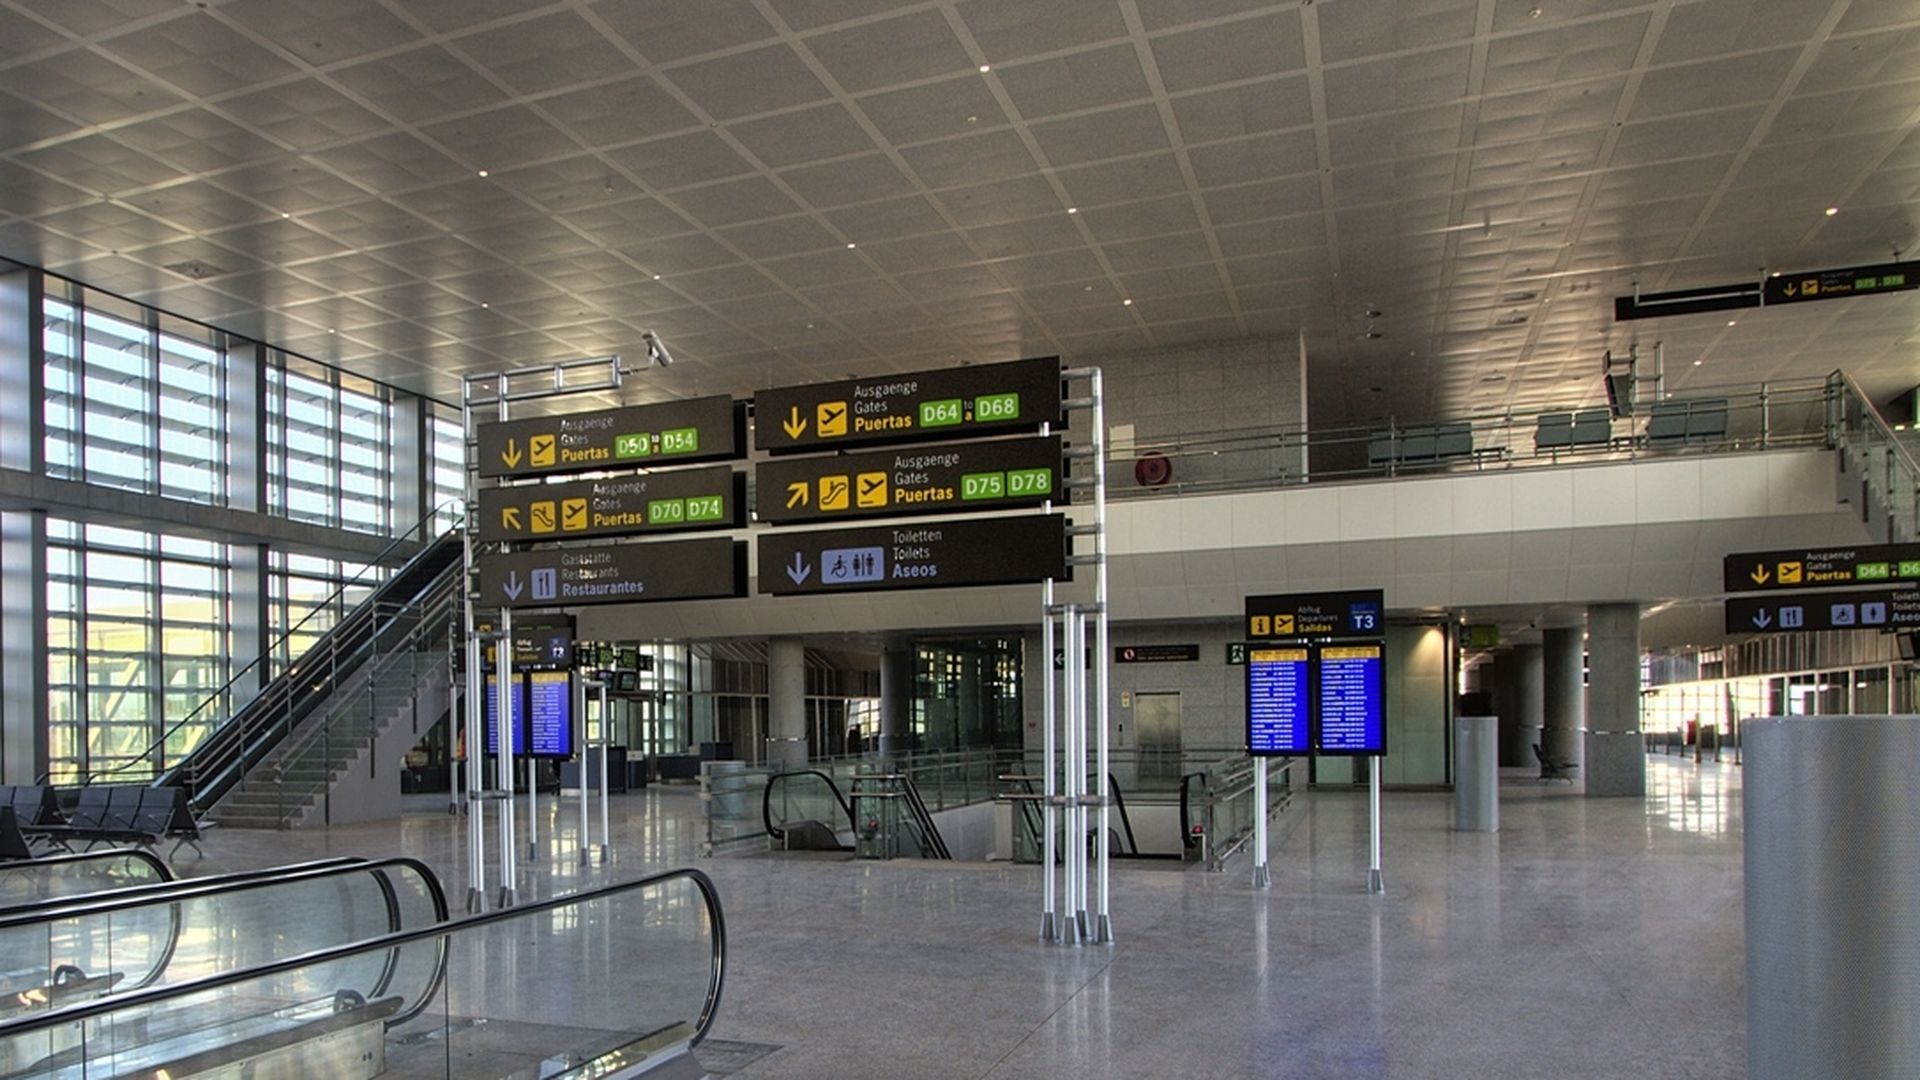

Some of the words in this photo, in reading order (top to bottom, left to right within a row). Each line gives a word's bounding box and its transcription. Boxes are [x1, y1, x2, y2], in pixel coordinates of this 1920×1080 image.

[854, 381, 918, 398] Ausgaenge
[854, 401, 888, 415] Gates
[855, 415, 912, 432] Puertas
[924, 404, 958, 423] D64
[979, 398, 1014, 417] D68
[560, 417, 613, 432] Ausgaenge
[561, 434, 589, 446] Gates
[561, 447, 609, 463] Puertas
[619, 437, 648, 454] D50
[664, 432, 693, 449] D54
[894, 453, 960, 469] Ausgaenge
[895, 472, 929, 486] Gates
[593, 481, 648, 496] Ausgaenge
[895, 487, 954, 503] Puertas
[966, 476, 1001, 495] D75
[1011, 473, 1047, 492] D78
[593, 498, 622, 510] Gates
[593, 512, 642, 527] Puertas
[652, 503, 681, 519] D70
[690, 500, 719, 516] D74
[892, 529, 943, 544] Toiletten
[892, 547, 930, 560] Toilets
[892, 563, 937, 579] Aseos
[1806, 562, 1833, 570] Gates
[1806, 571, 1852, 581] Puertas
[1860, 565, 1887, 577] D64
[562, 581, 644, 597] Restaurantes
[1298, 623, 1332, 633] Salidas
[1354, 615, 1374, 629] T3
